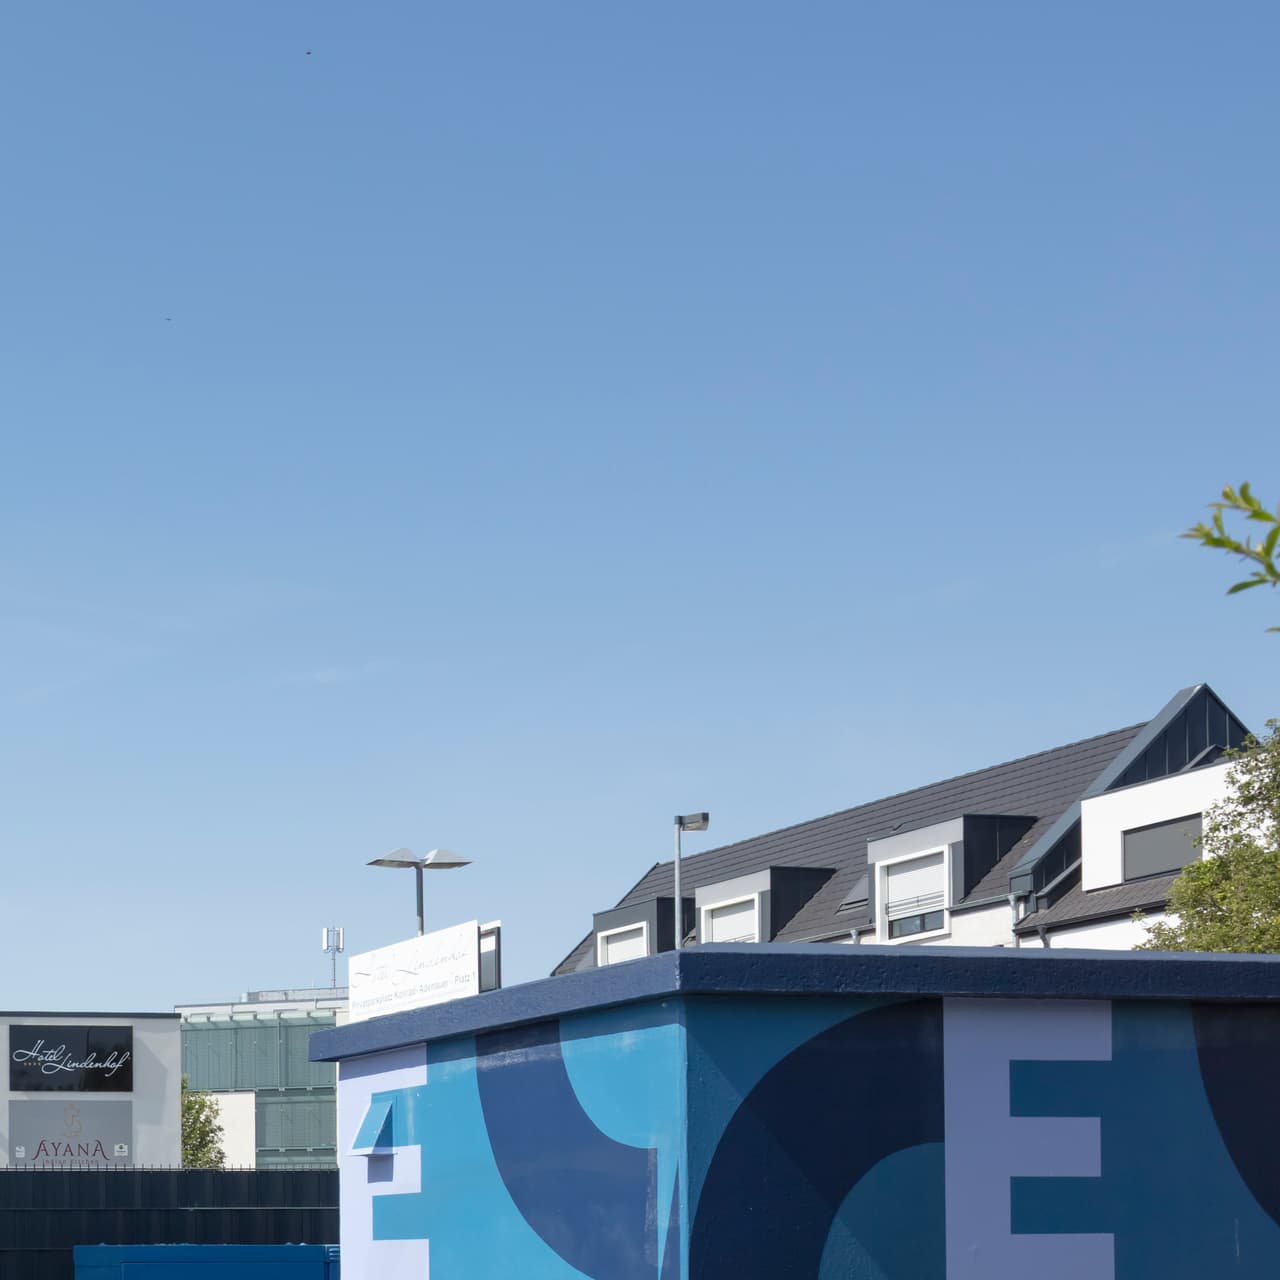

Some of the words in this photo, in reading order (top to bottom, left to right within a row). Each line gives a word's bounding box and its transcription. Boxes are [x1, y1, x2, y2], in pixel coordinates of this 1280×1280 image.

[12, 1039, 66, 1063] Hotel
[41, 1051, 130, 1077] Lindenhof
[32, 1139, 111, 1161] AYANA
